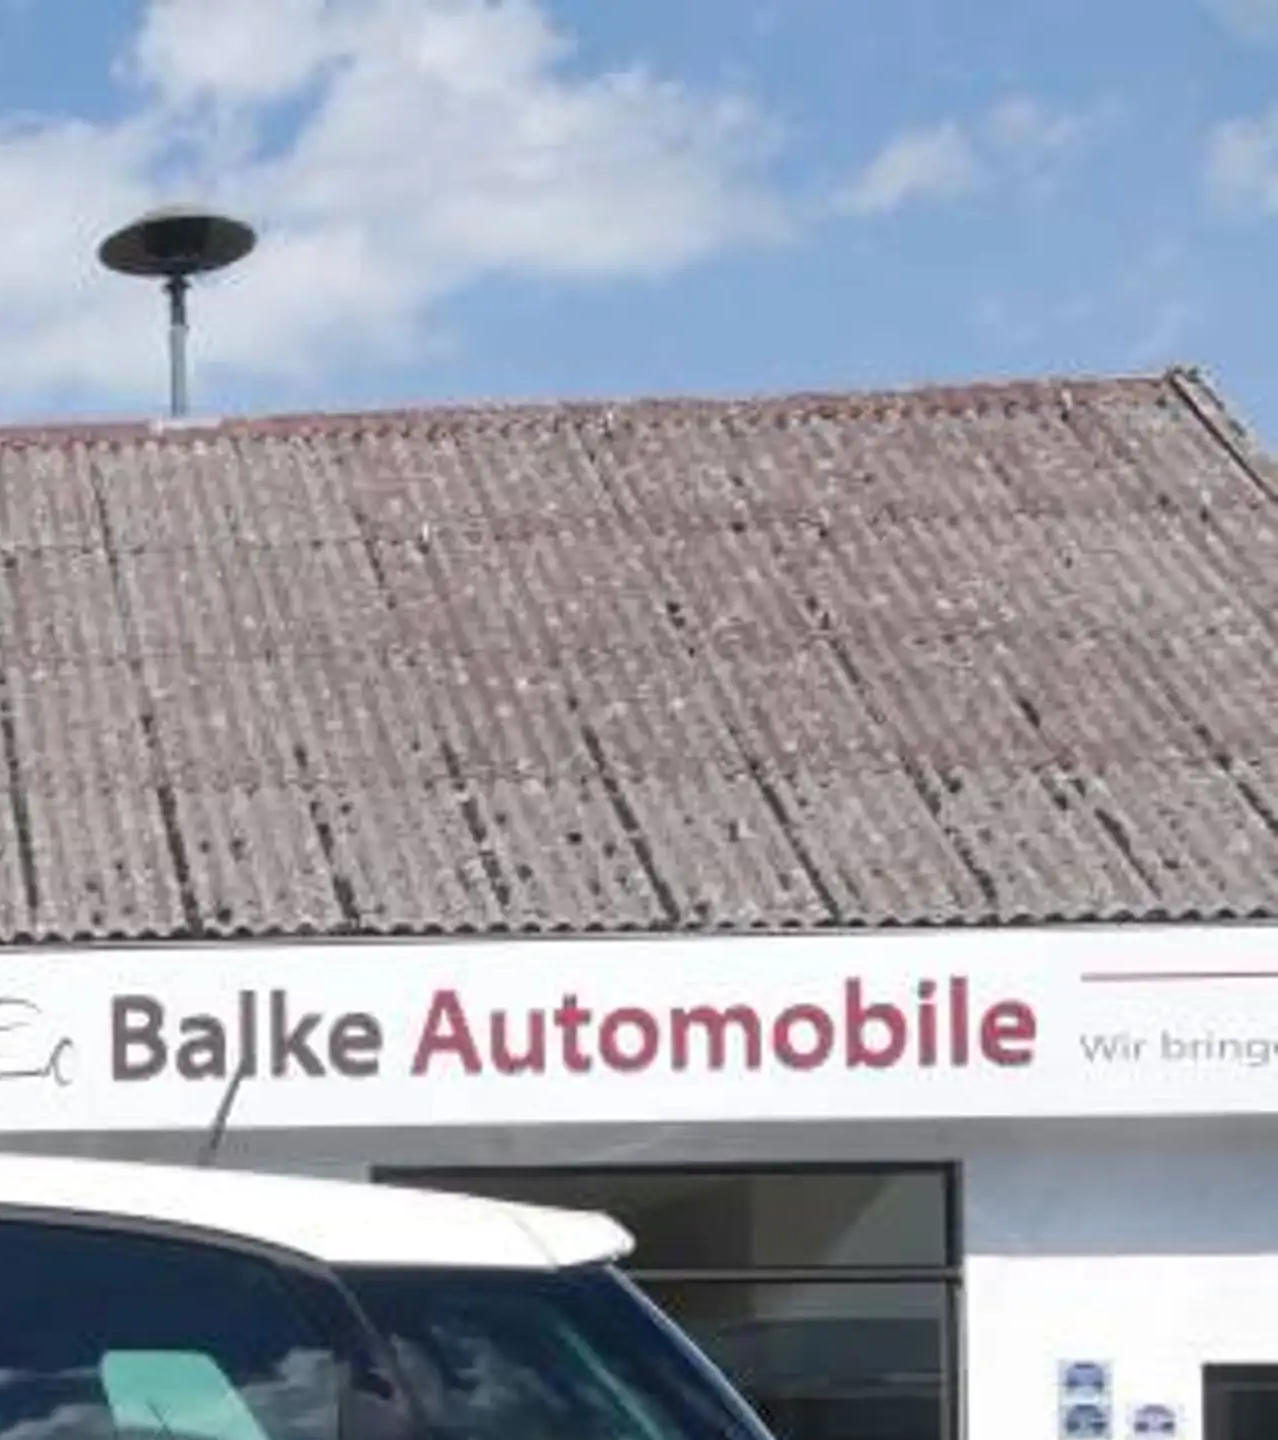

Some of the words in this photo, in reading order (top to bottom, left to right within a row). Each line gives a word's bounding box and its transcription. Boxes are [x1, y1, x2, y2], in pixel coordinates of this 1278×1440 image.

[111, 989, 383, 1081] Balke
[410, 977, 1039, 1076] Automobile
[1080, 1033, 1148, 1063] Wir
[1160, 1030, 1278, 1068] bring
